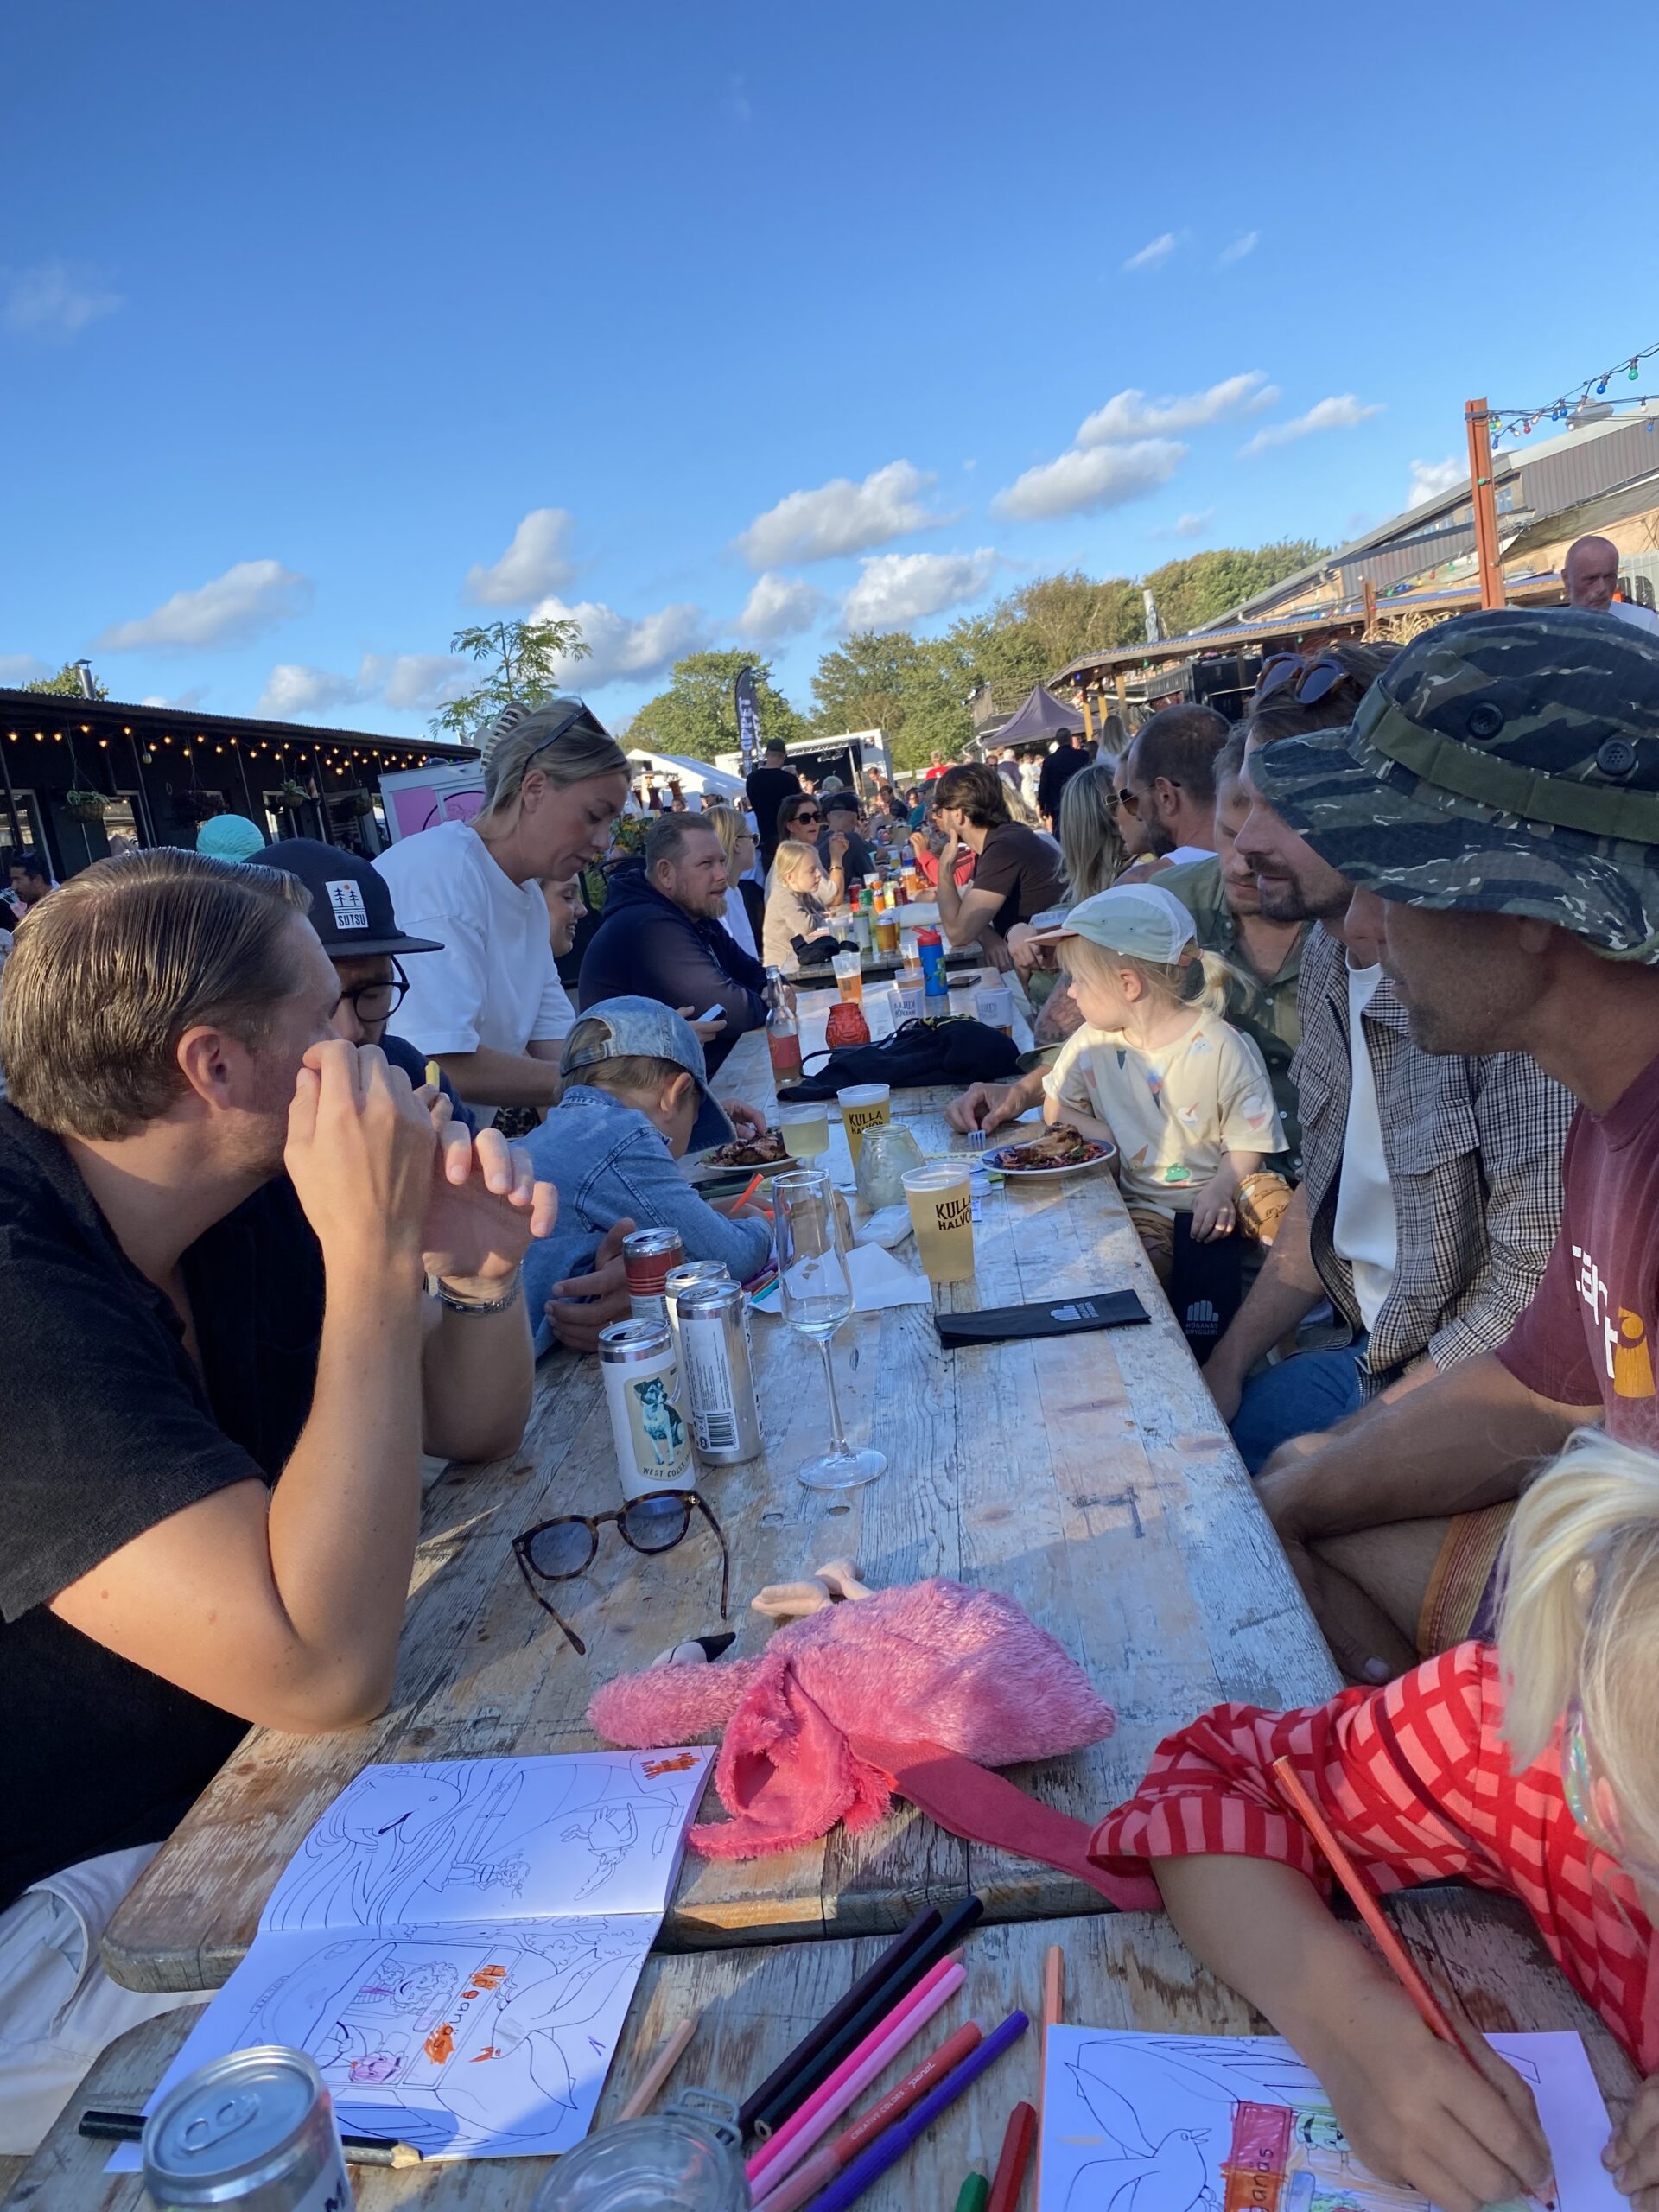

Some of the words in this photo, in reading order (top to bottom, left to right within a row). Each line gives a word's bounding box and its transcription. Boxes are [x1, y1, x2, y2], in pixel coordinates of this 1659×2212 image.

[337, 913, 366, 926] SUTSU
[849, 1110, 883, 1127] KULLA
[643, 1467, 664, 1478] WEST
[880, 2089, 905, 2113] COLORS
